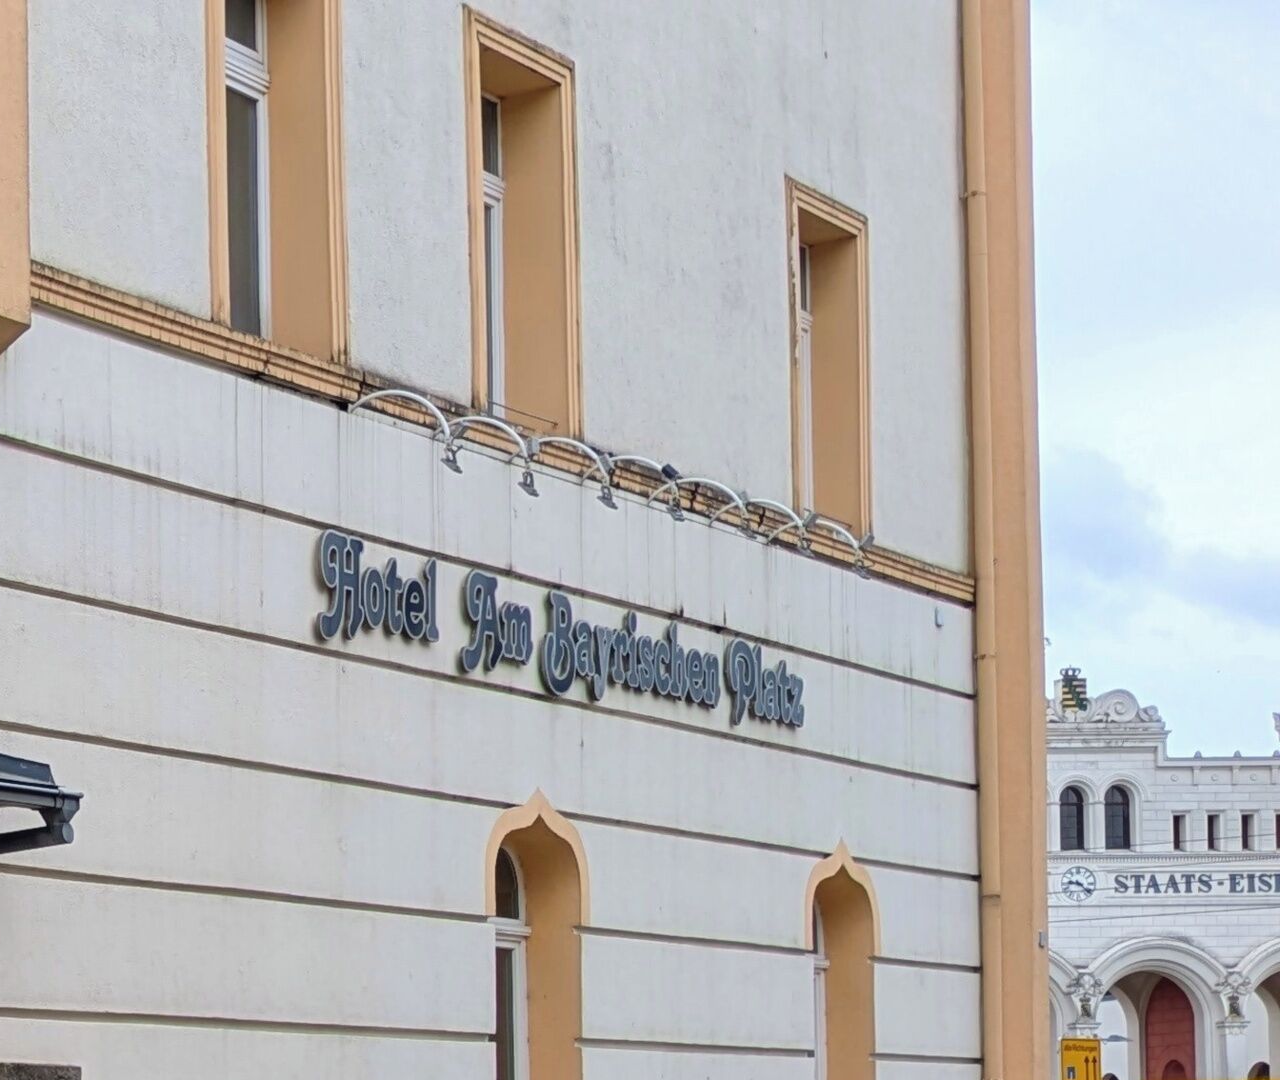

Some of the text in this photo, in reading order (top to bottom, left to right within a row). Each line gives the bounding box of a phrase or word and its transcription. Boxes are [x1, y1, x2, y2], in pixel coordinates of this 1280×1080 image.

[318, 528, 806, 729] Hotel Am Bayrischen Platz
